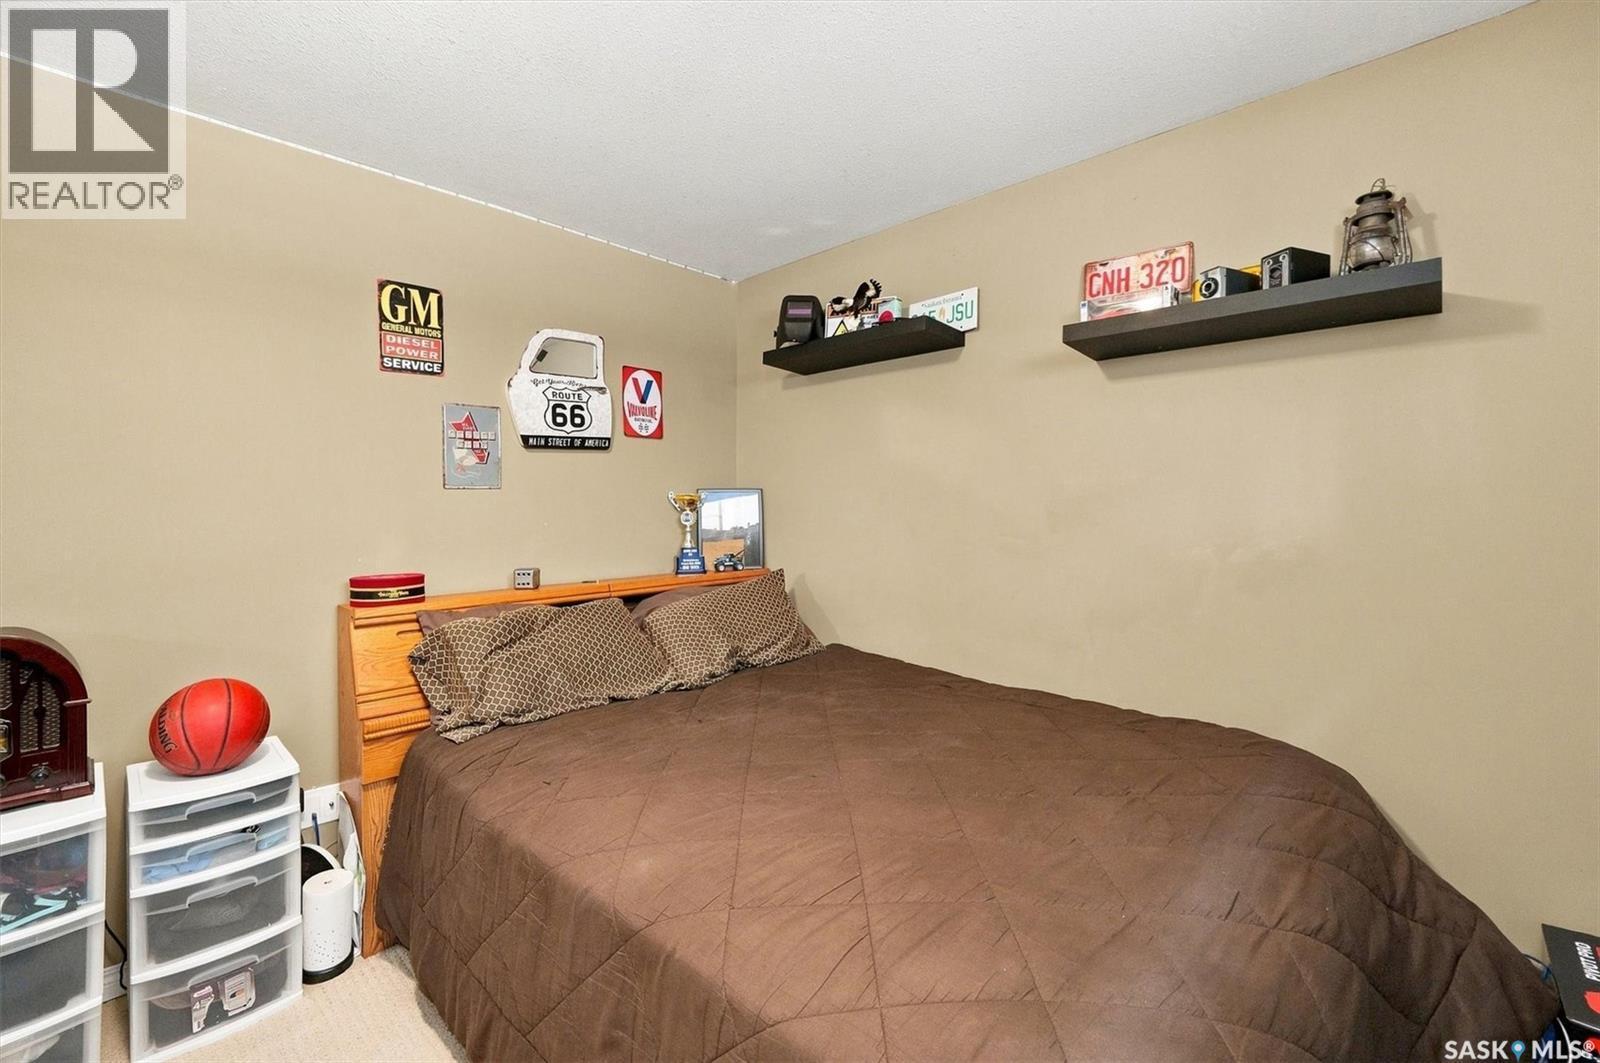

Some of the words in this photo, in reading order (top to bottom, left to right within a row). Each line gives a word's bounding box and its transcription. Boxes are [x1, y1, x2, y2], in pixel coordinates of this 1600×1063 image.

[1089, 267, 1131, 298] CNH
[1140, 256, 1185, 289] 320
[381, 284, 441, 330] GM
[946, 300, 974, 323] JSU
[382, 322, 413, 334] GENERAL
[414, 327, 442, 338] MOTORS
[386, 334, 438, 350] DIESEL
[386, 345, 438, 360] POWER
[383, 357, 442, 373] SERVICE
[552, 391, 583, 401] ROUTE
[551, 403, 586, 428] 66
[627, 401, 657, 420] VALVOLINE
[528, 437, 545, 446] MAIN
[548, 438, 571, 447] STREET
[573, 438, 582, 447] OF
[584, 438, 609, 448] AMERICA
